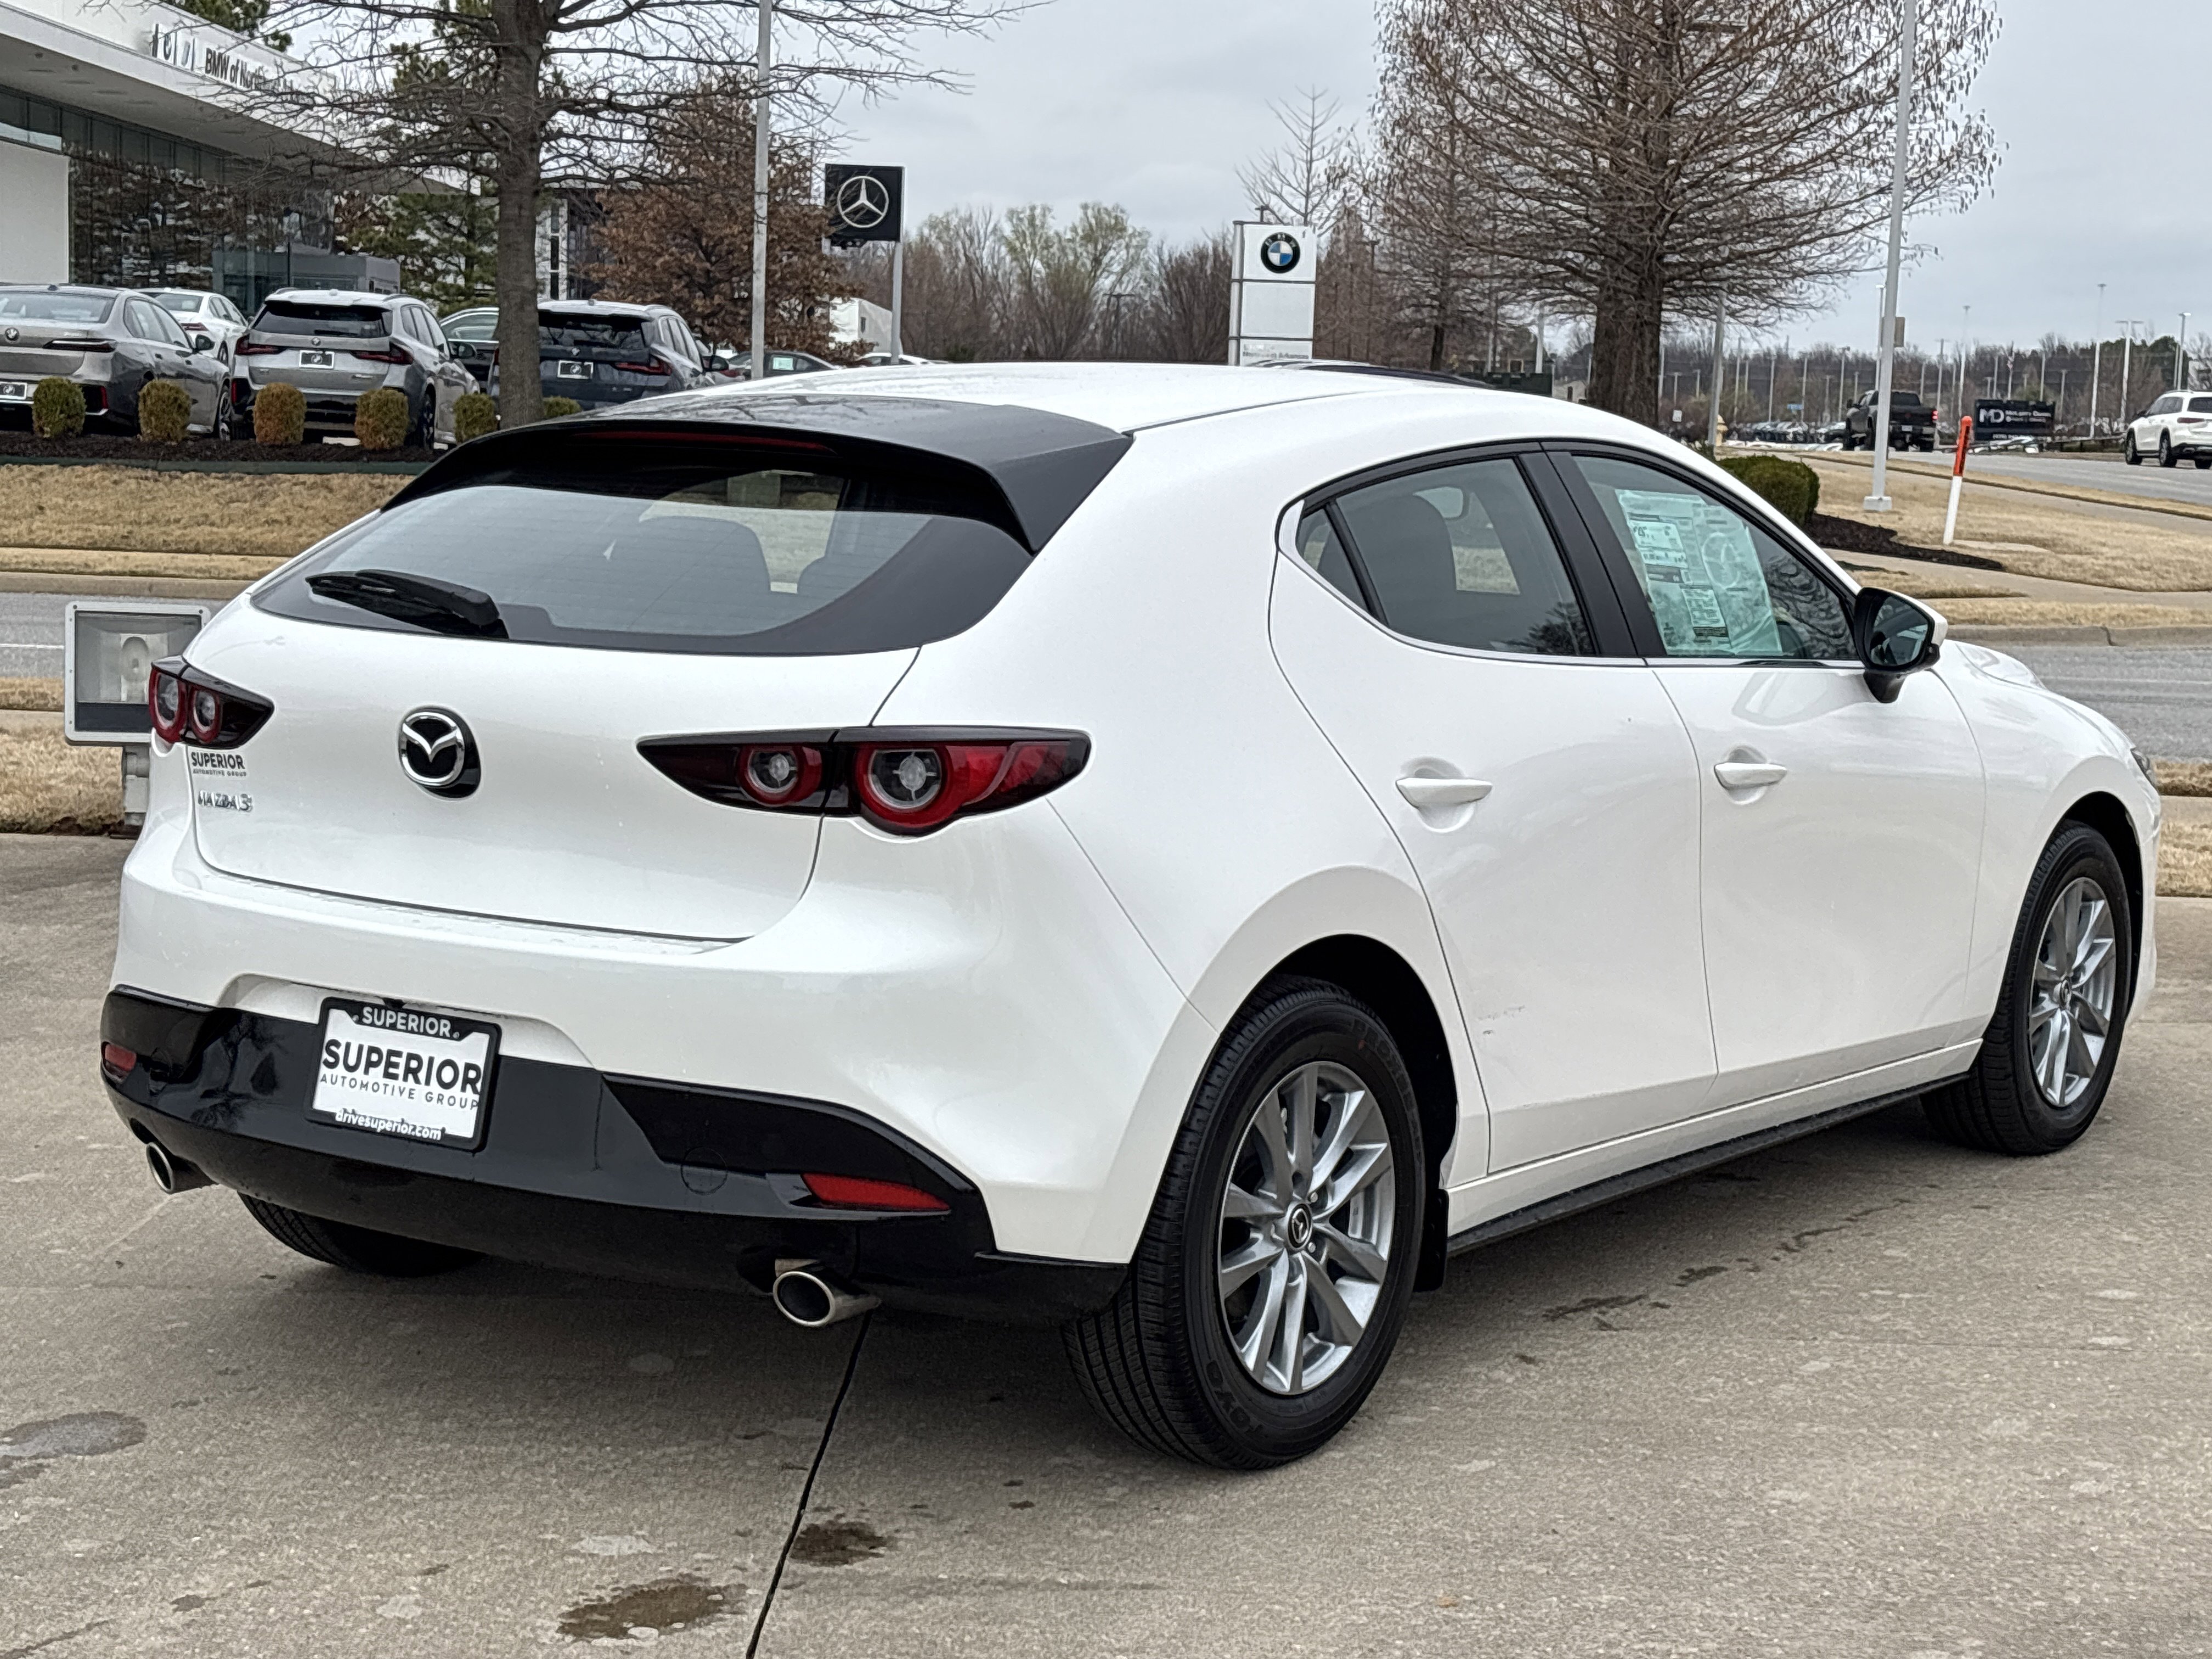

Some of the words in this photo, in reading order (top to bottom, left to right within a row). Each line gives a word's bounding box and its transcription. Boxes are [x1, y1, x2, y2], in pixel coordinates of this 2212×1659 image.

[205, 48, 230, 80] BMW
[230, 59, 240, 84] of
[191, 752, 245, 769] SUPERIOR
[362, 1007, 451, 1038] SUPERIOR
[323, 1039, 482, 1094] SUPERIOR
[320, 1074, 415, 1099] AUTOMOTIVE
[425, 1091, 479, 1110] GROUP
[335, 1109, 442, 1141] drivesuperior.com
